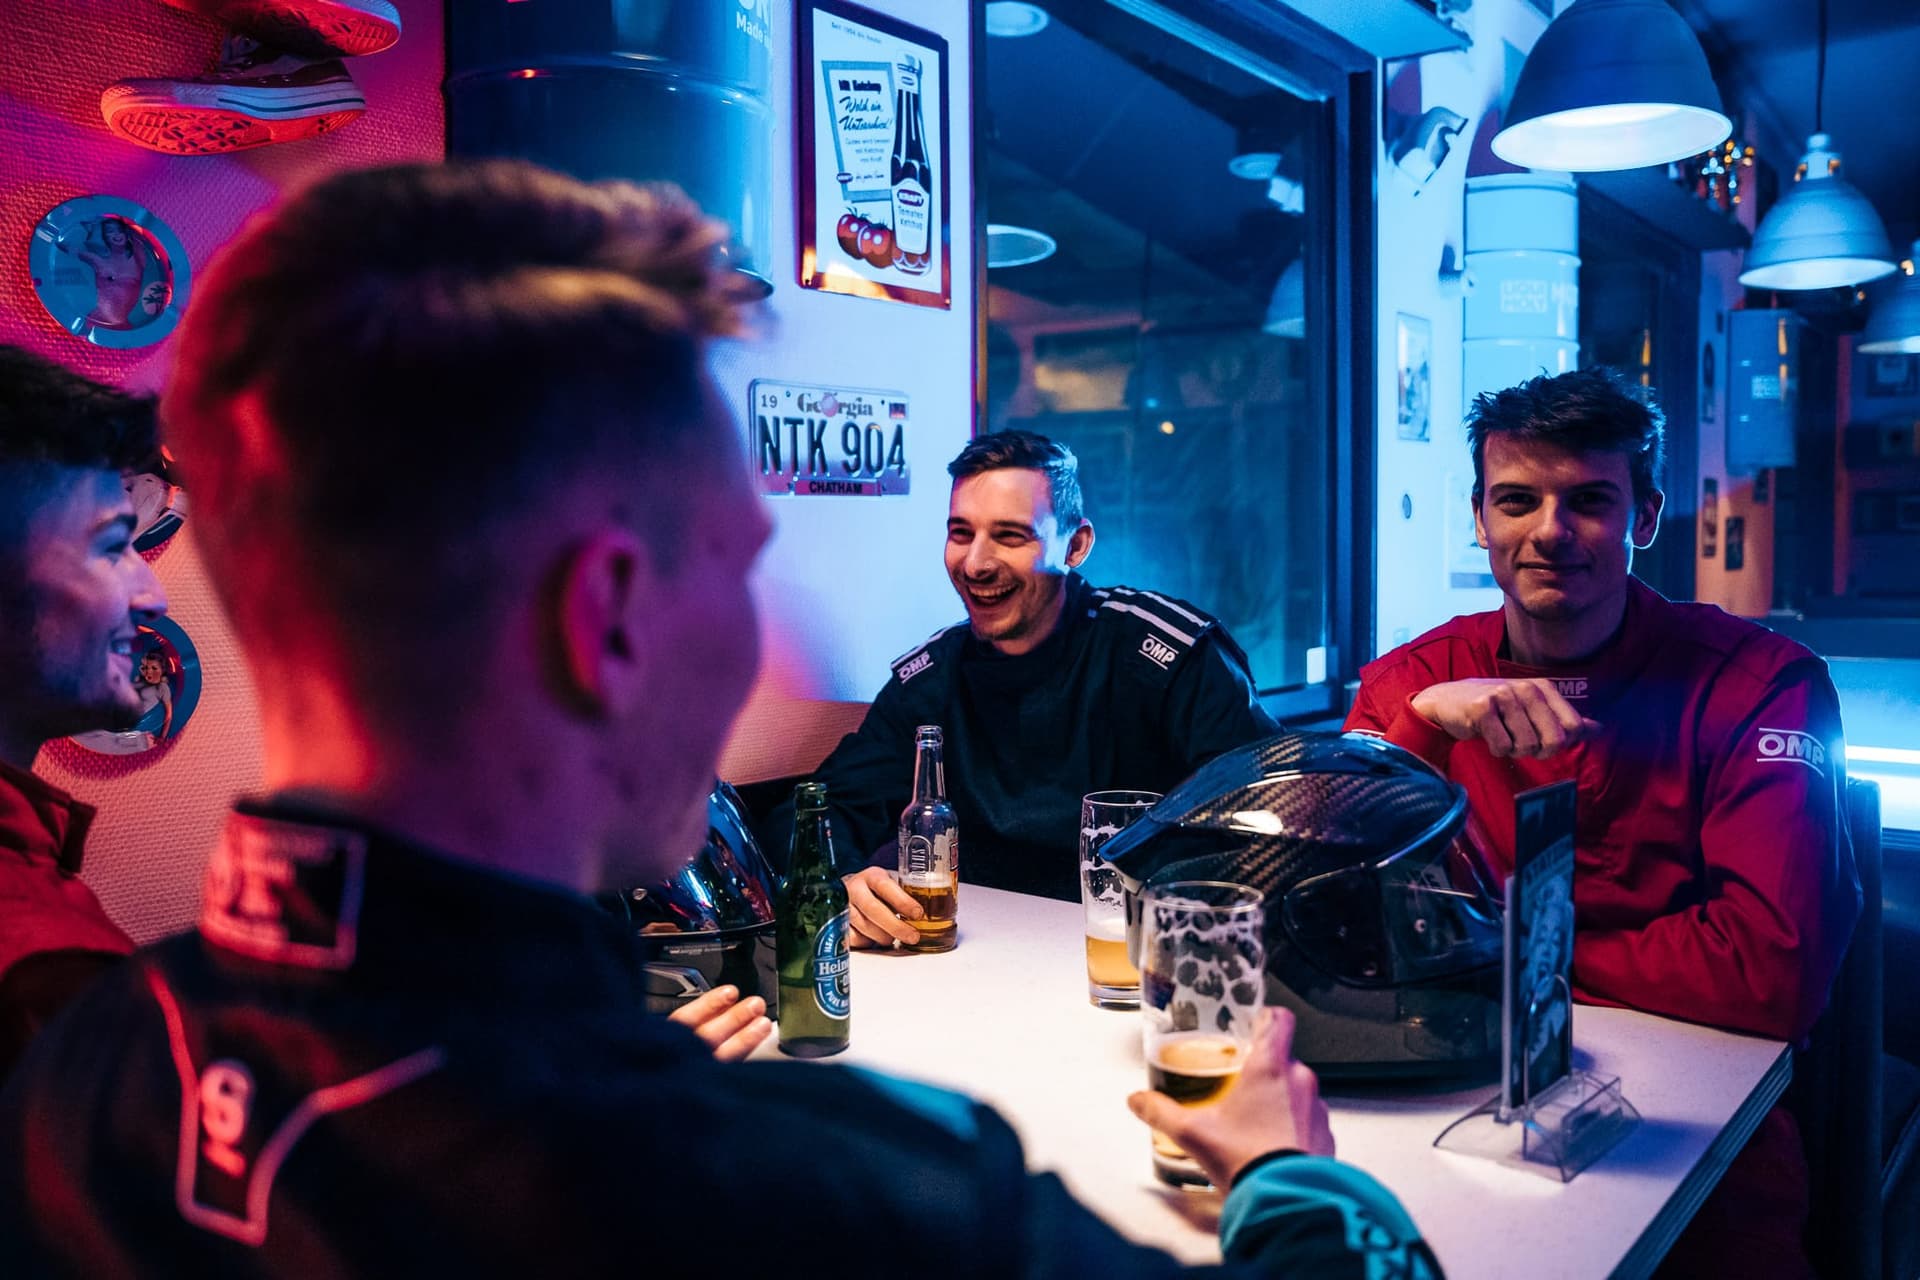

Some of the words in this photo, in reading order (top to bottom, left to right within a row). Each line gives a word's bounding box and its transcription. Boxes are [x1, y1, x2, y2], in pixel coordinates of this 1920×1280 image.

[736, 11, 764, 43] Made
[761, 394, 778, 409] 19
[758, 415, 831, 475] NTK
[841, 420, 906, 478] 904
[809, 481, 863, 494] CHATHAM
[1142, 638, 1176, 664] OMP
[899, 652, 931, 679] OMP
[1553, 680, 1588, 695] MP
[1758, 733, 1825, 765] OMP
[818, 958, 849, 977] Hein
